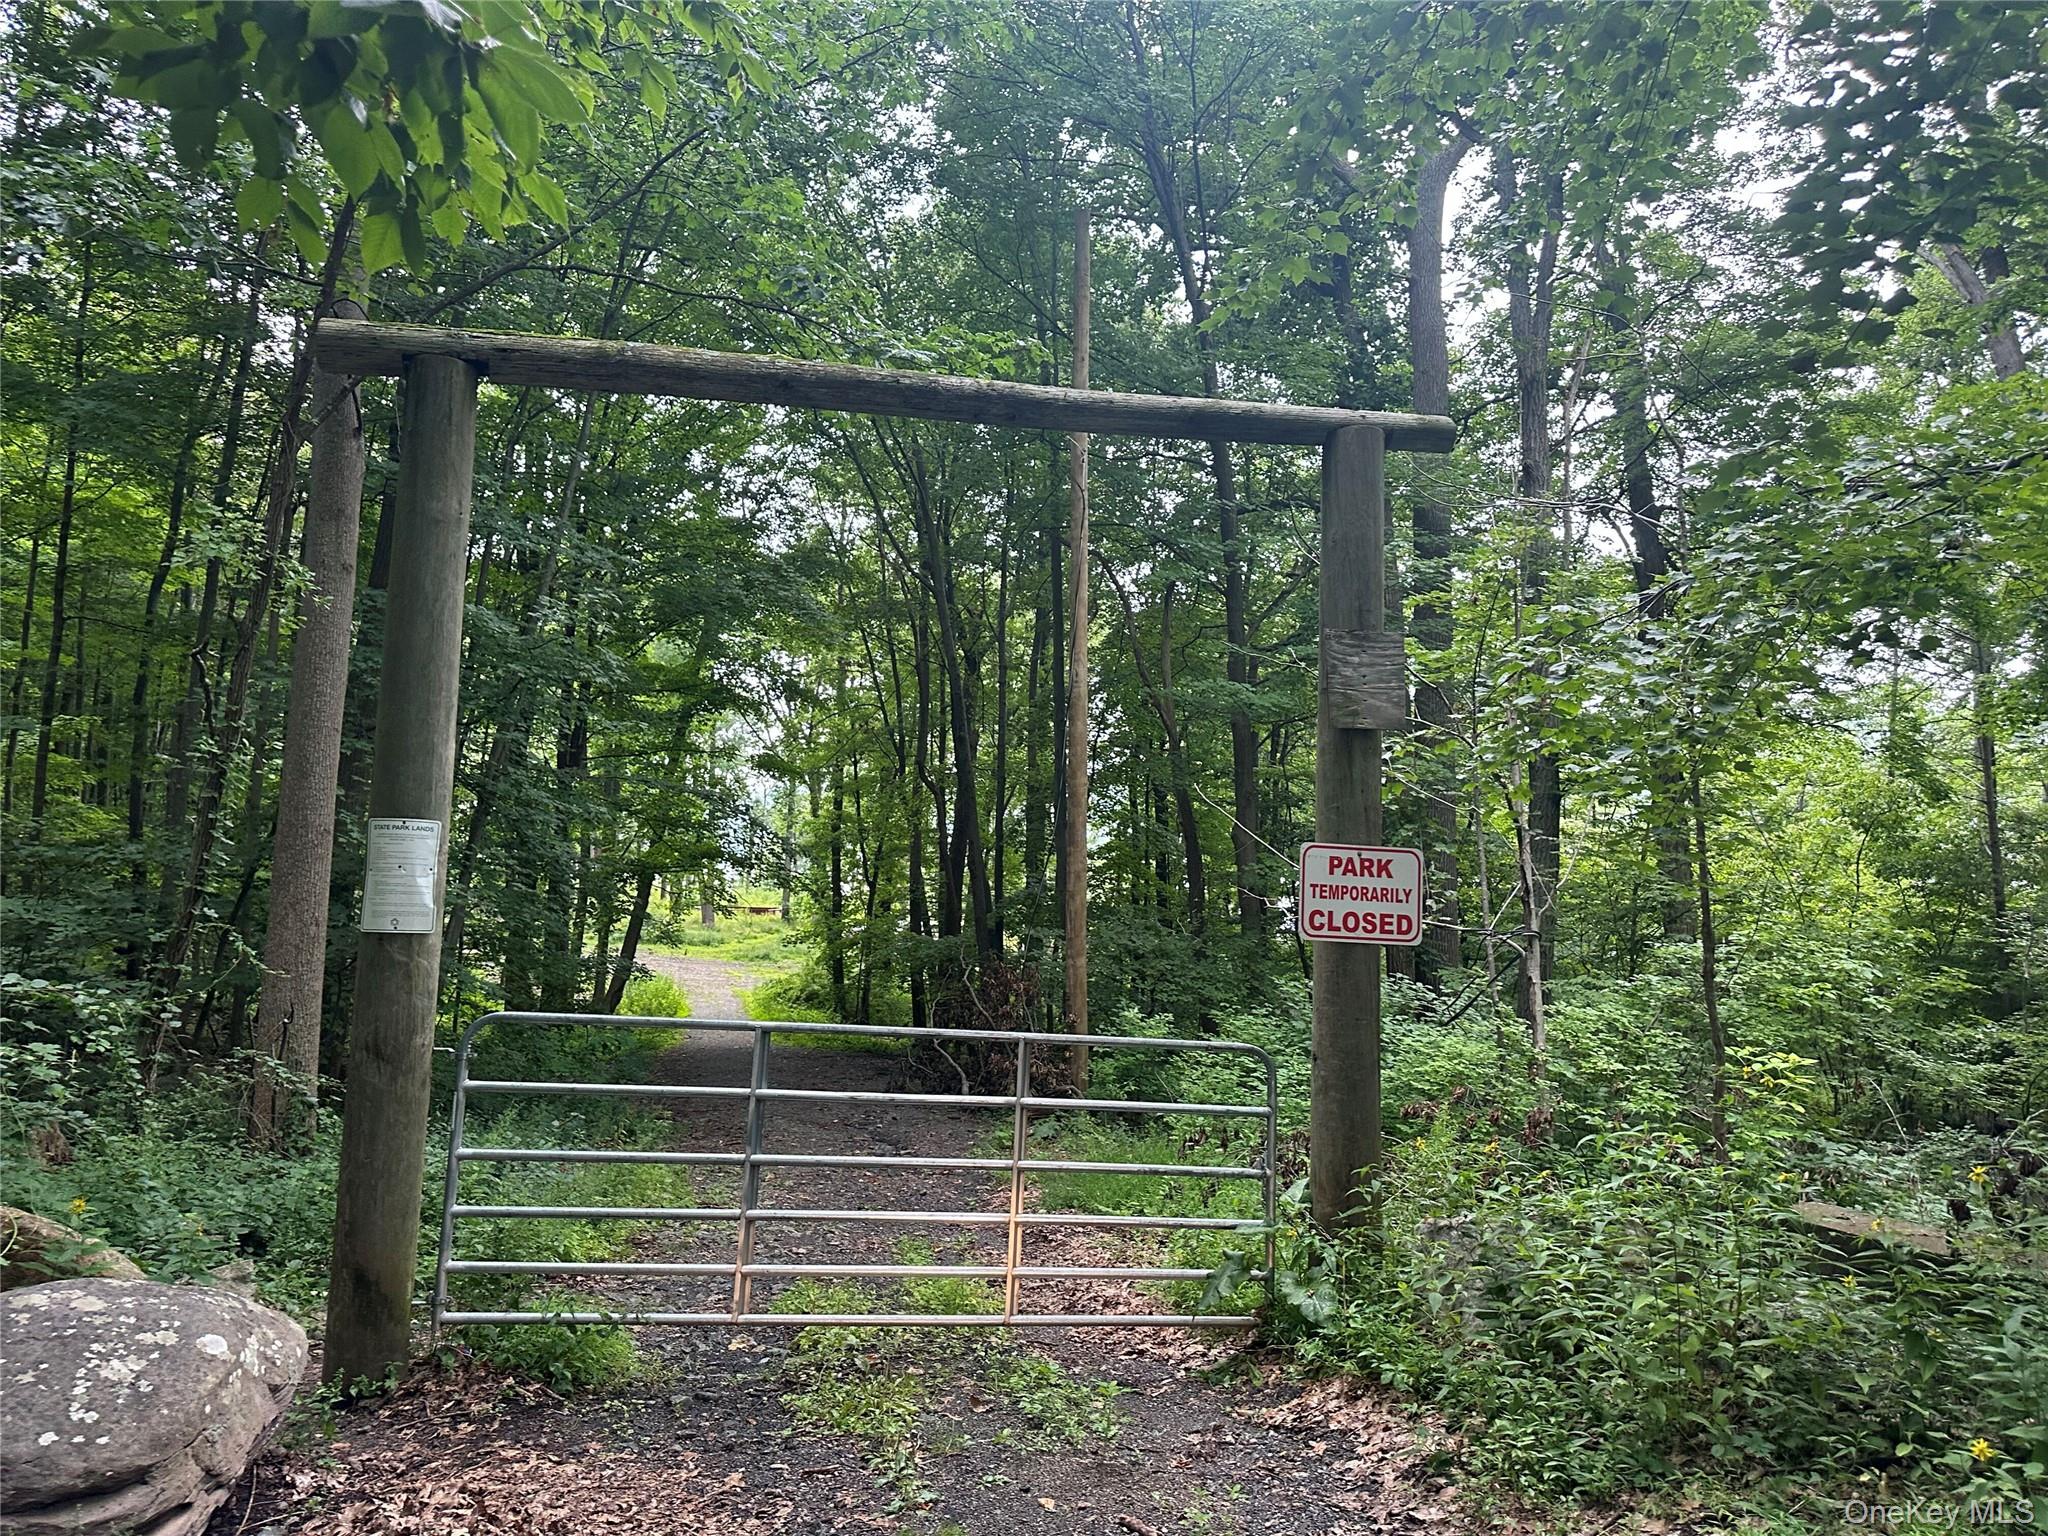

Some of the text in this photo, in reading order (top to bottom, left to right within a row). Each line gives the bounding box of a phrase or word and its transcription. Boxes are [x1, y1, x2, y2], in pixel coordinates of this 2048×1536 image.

[1328, 855, 1394, 879] PARK
[1309, 883, 1413, 904] TEMPORARILY
[1308, 909, 1413, 935] CLOSED
